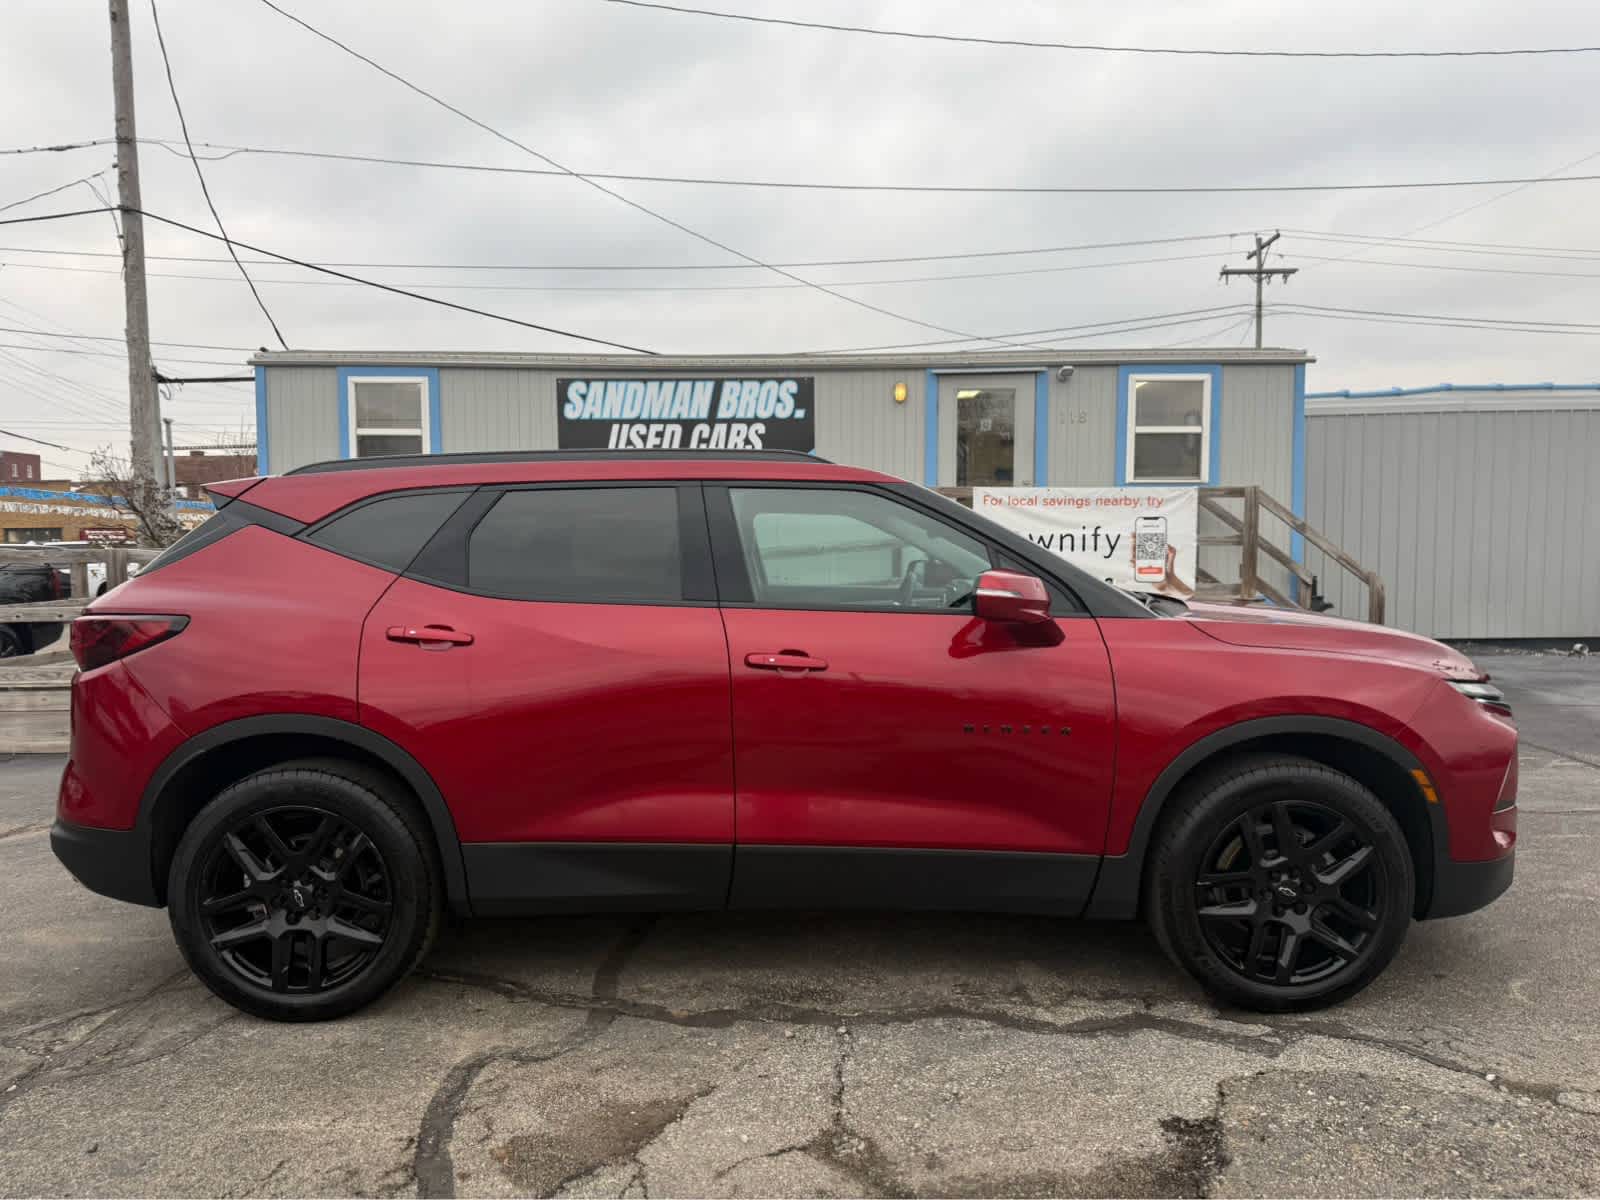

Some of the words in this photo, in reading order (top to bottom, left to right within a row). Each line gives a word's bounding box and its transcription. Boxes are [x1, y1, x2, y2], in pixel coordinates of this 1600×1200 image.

[564, 380, 715, 420] SANDMAN
[716, 380, 806, 419] BROS.
[608, 423, 683, 449] USED
[689, 423, 766, 450] CARS
[983, 495, 1003, 507] For
[1007, 495, 1038, 507] local
[1042, 495, 1090, 509] savings
[1146, 495, 1164, 509] try
